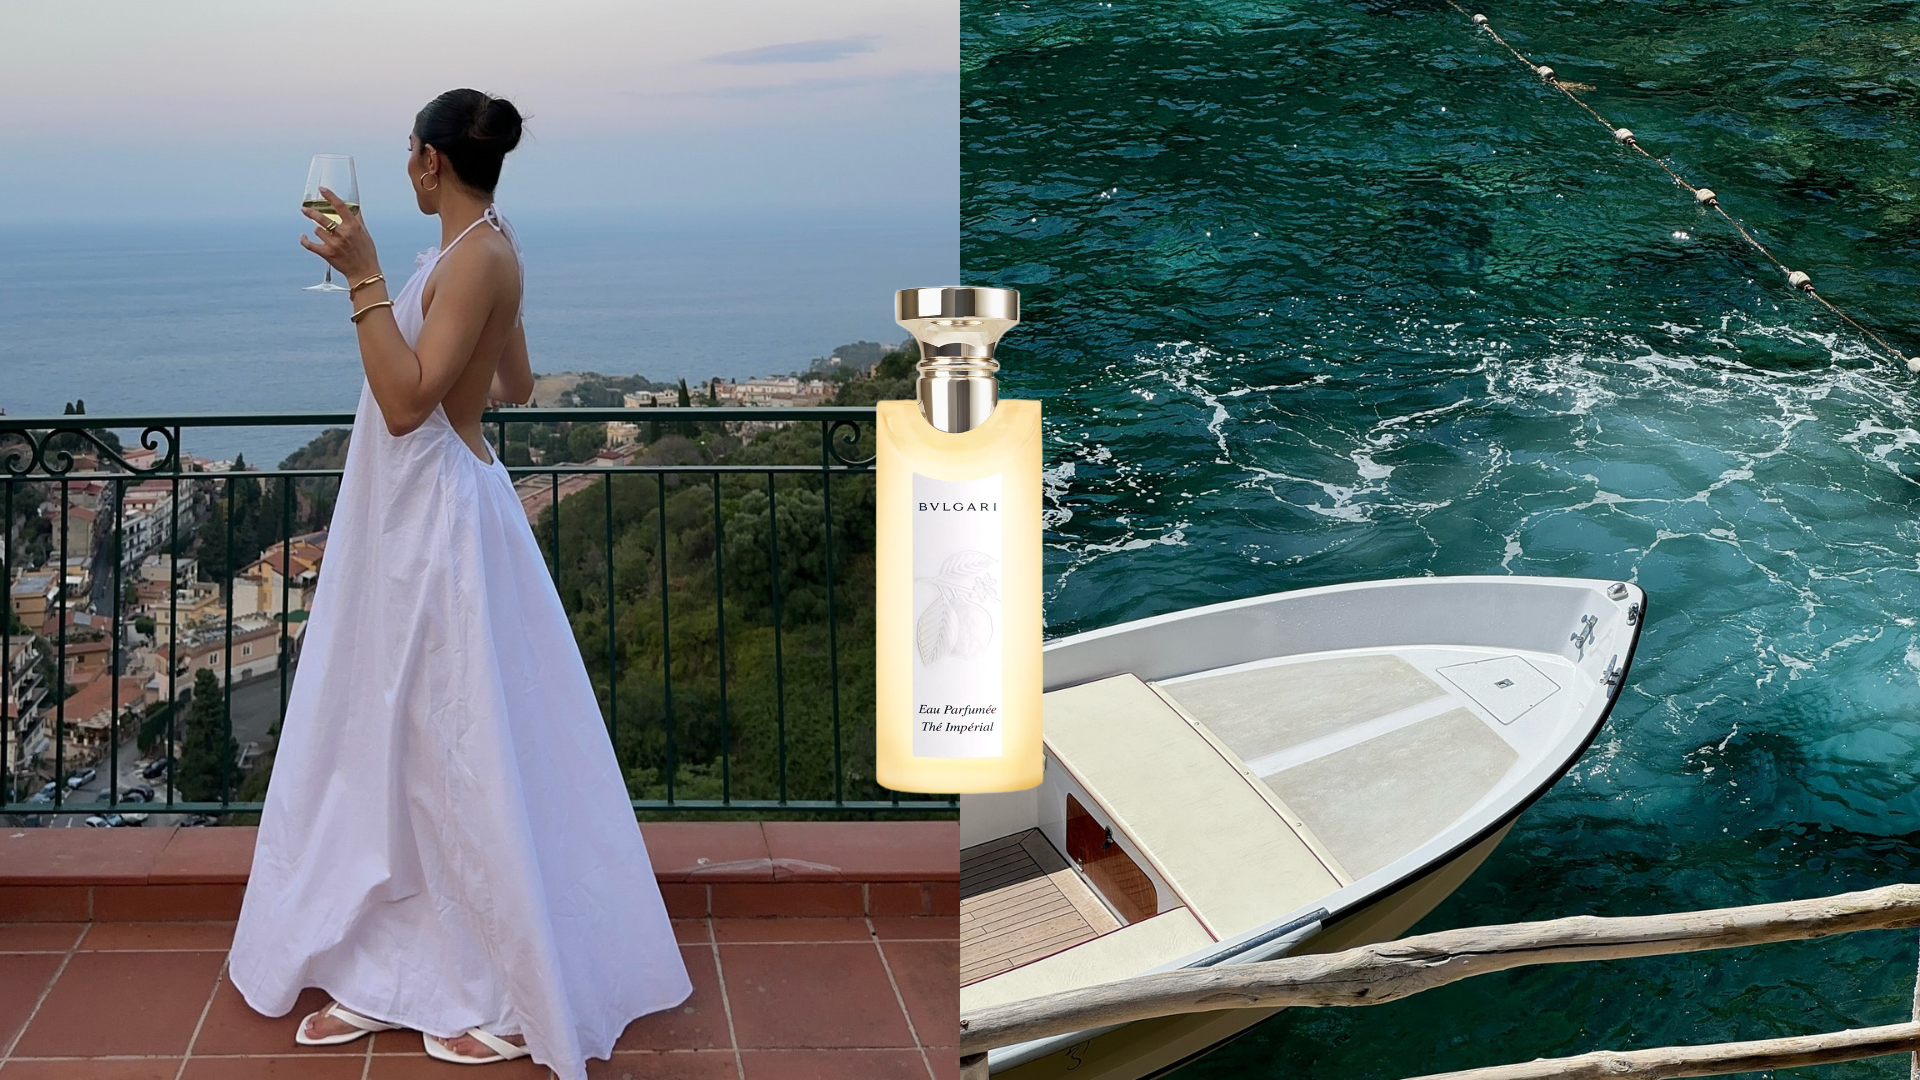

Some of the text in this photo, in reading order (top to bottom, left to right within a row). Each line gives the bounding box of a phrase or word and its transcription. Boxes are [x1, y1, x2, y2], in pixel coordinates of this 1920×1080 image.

[918, 502, 997, 512] BVLGARI
[918, 704, 997, 717] Eau Parfumée
[921, 721, 994, 735] Thé Impérial
